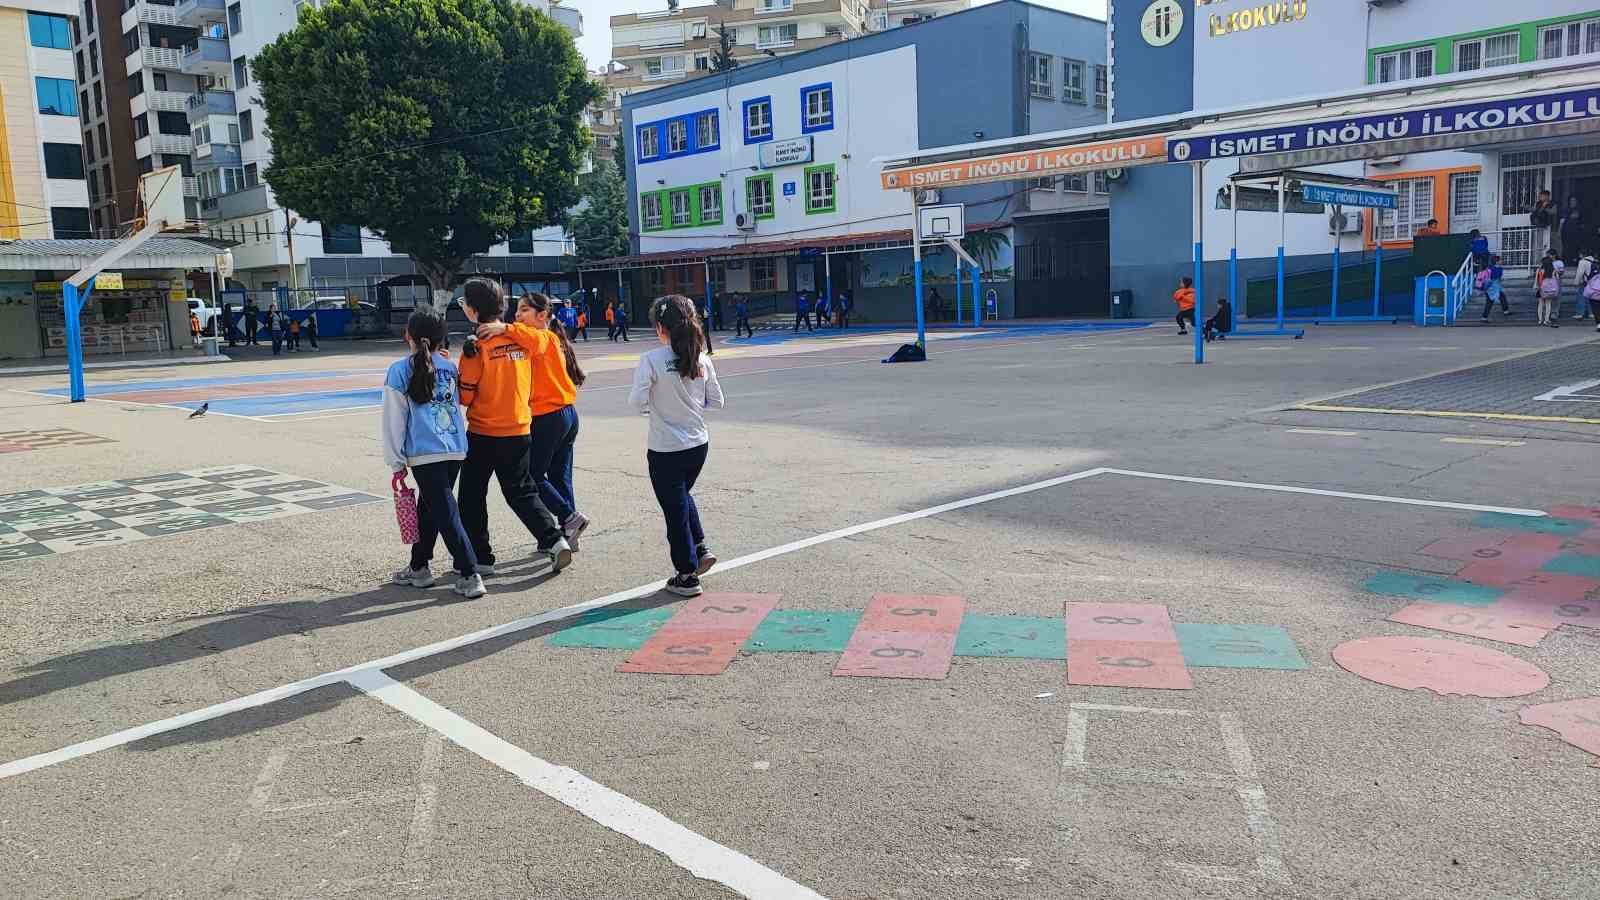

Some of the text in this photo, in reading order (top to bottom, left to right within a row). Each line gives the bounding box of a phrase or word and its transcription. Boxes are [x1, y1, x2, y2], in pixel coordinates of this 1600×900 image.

[1208, 0, 1308, 39] İLKOKULU
[1209, 133, 1297, 158] İSMET
[1306, 116, 1410, 147] İNÖNÜ
[967, 156, 1031, 178] İNÖNÜ
[1036, 143, 1148, 170] İLKOKULU
[701, 605, 748, 614] 2
[889, 608, 938, 617] 5
[1092, 615, 1144, 625] 8
